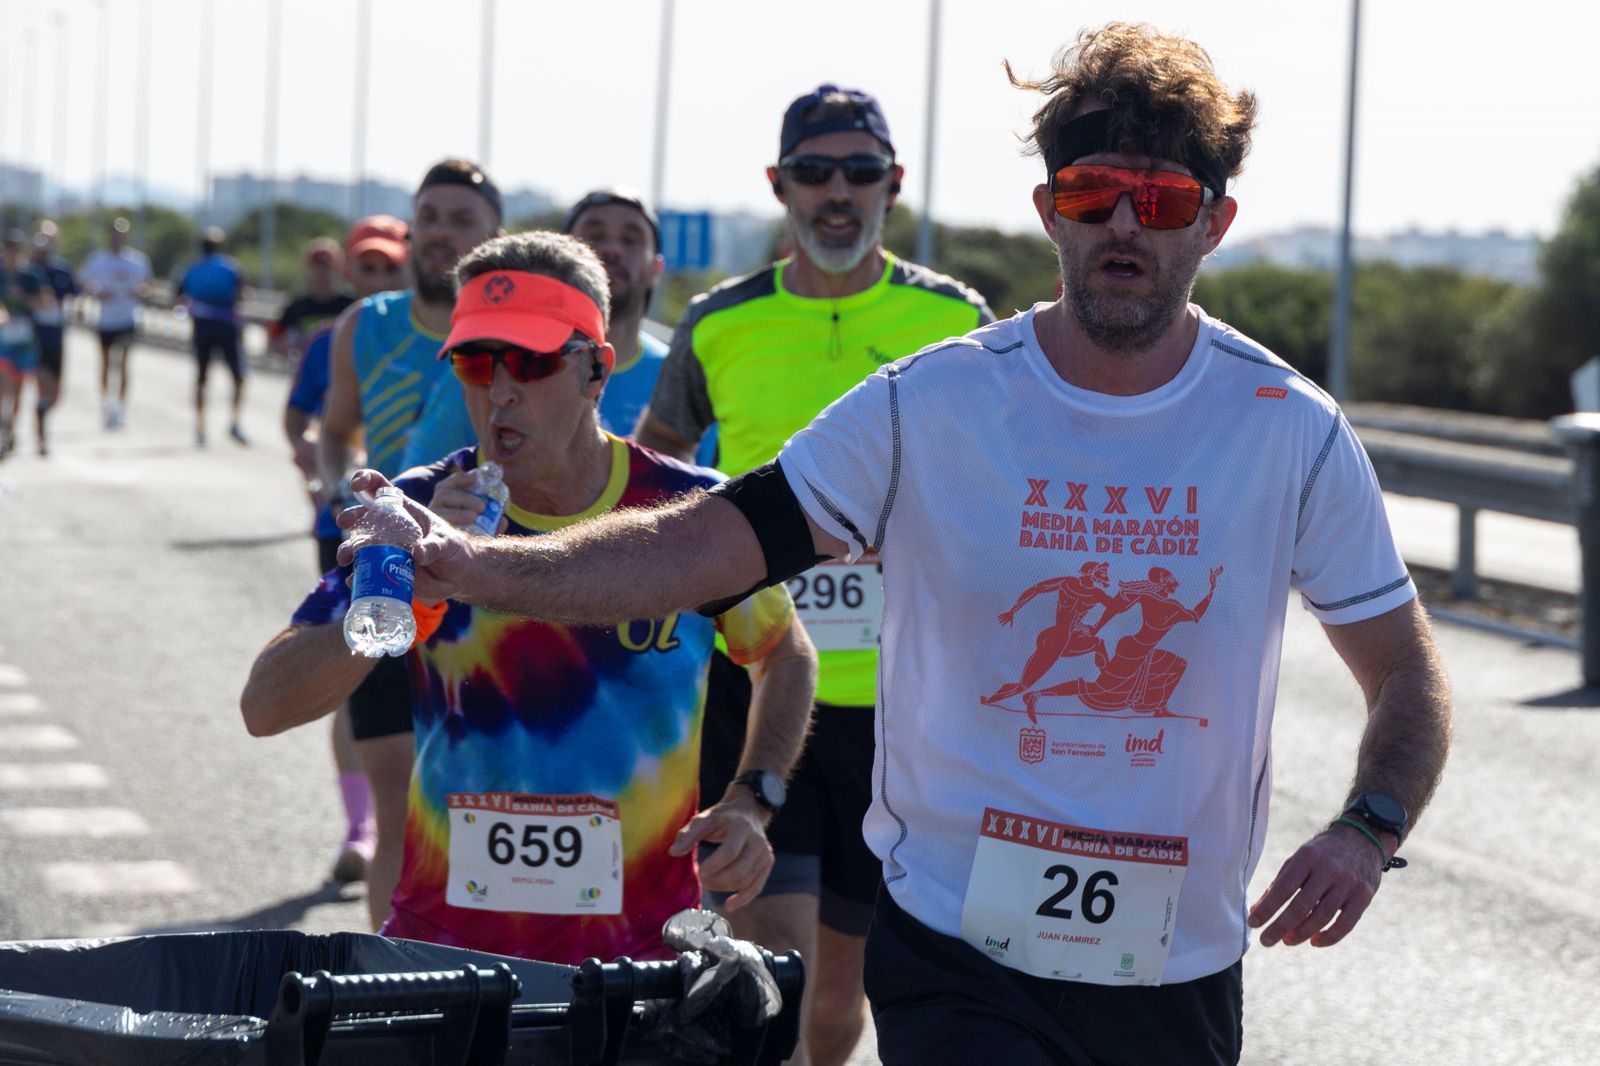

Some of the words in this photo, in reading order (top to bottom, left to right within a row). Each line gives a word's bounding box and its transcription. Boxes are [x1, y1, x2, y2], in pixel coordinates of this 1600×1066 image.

[1021, 511, 1088, 533] MEDIA
[1092, 515, 1199, 536] MARATÓN
[1019, 530, 1089, 552] BAHÍA
[1095, 537, 1123, 554] DE
[1130, 535, 1199, 556] CÁDIZ
[785, 573, 864, 610] 296
[1125, 727, 1164, 754] imd
[556, 804, 574, 814] DE
[487, 821, 583, 868] 659
[1061, 838, 1111, 855] BAHÍA
[1115, 845, 1134, 857] DE
[1137, 846, 1183, 861] CÁDIZ
[1063, 829, 1109, 845] MEDIA
[1035, 864, 1119, 925] 26
[1036, 931, 1061, 941] JUAN
[1063, 934, 1102, 945] RAMIREZ
